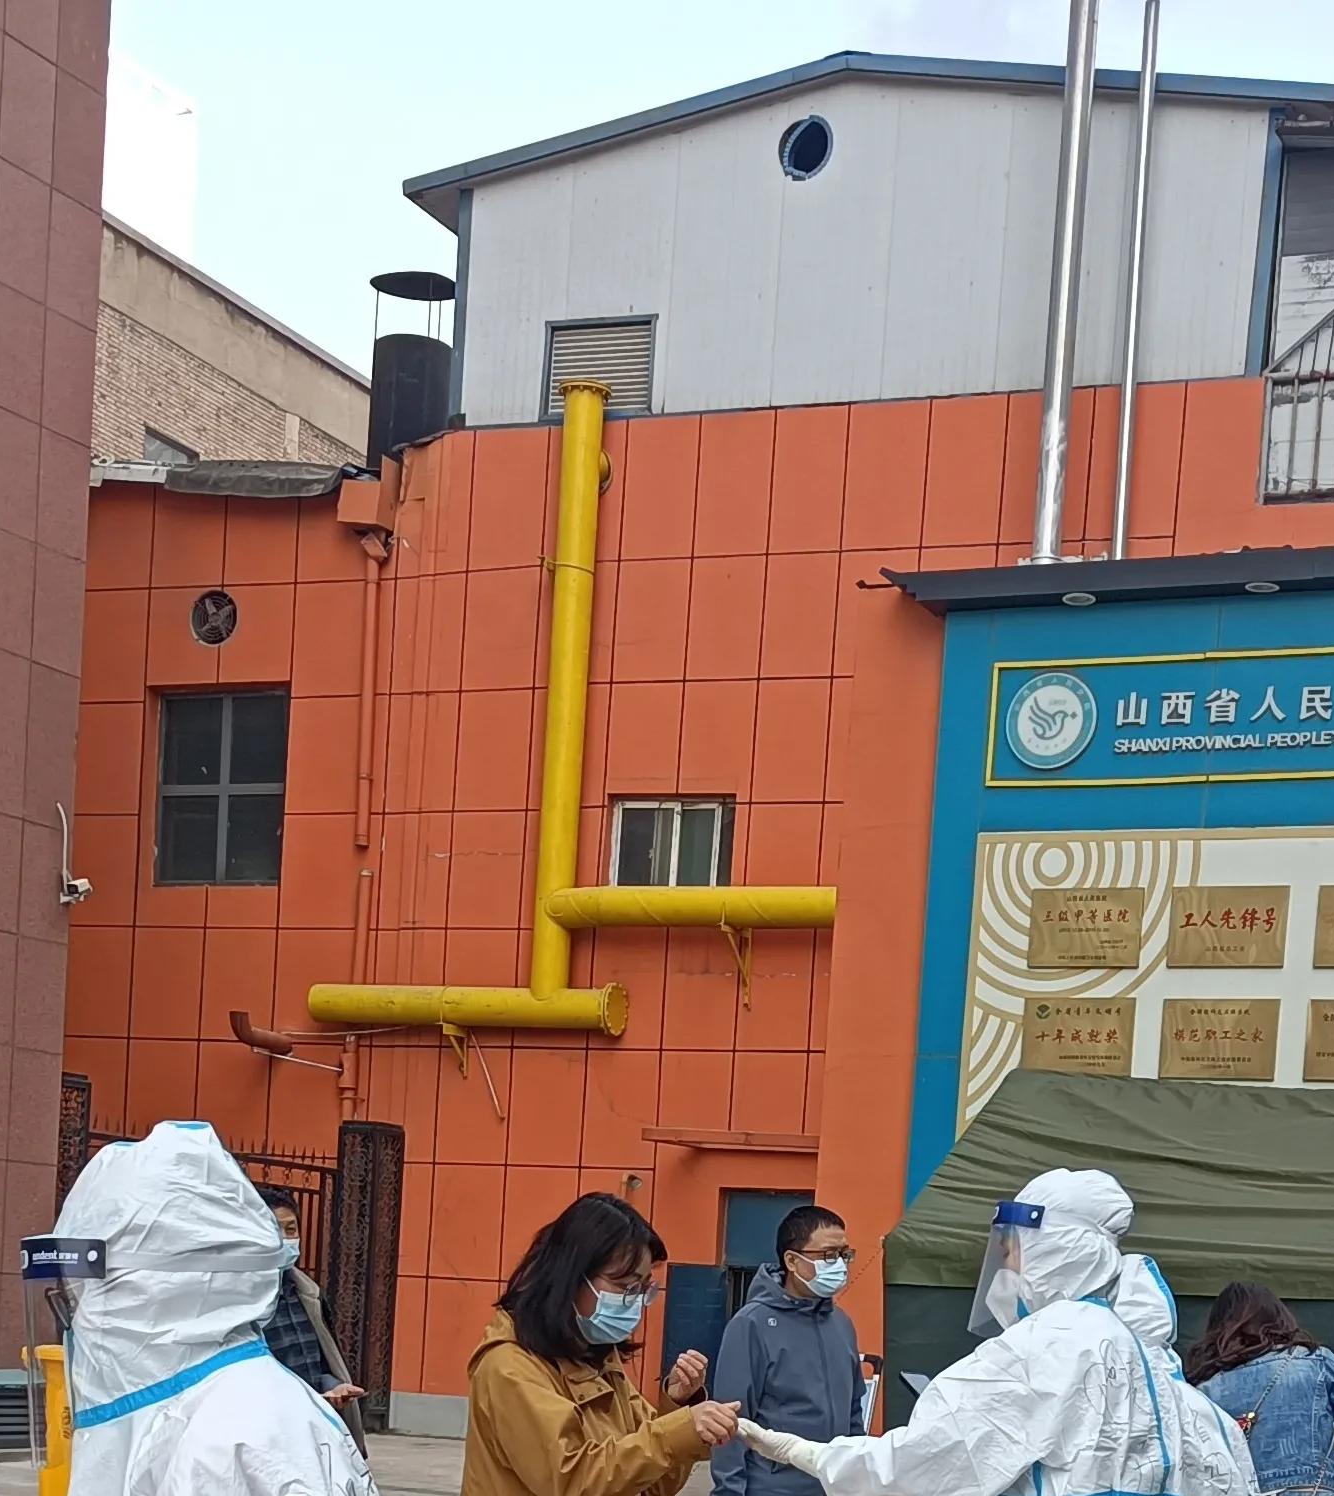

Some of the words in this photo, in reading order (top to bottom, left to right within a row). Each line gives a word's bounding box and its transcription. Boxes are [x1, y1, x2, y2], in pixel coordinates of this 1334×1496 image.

[1113, 737, 1170, 754] SHANXI
[1171, 733, 1266, 752] PROVINCIAL
[1042, 908, 1131, 925] 三级甲等医院
[1179, 907, 1278, 935] 工人先锋号
[1172, 1028, 1266, 1043] 模范职工之家
